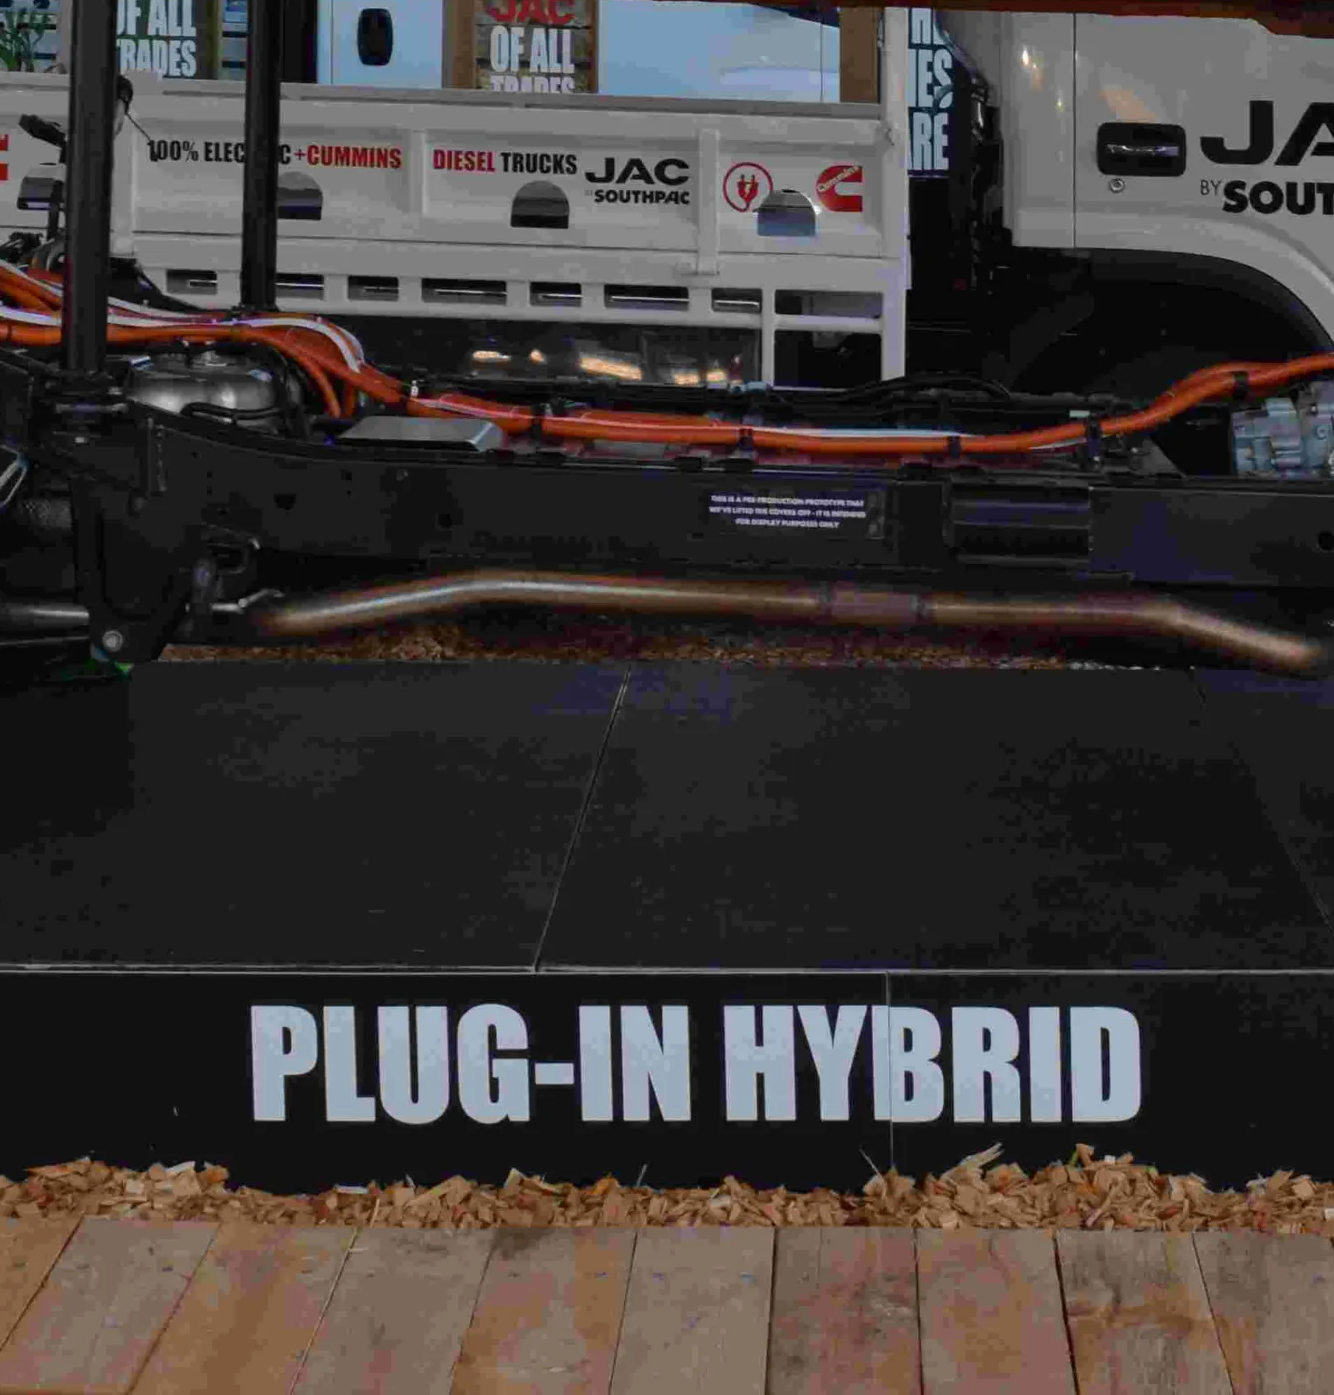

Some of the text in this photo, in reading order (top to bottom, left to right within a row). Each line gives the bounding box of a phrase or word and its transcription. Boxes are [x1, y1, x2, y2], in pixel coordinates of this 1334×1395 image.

[116, 38, 198, 77] RADES
[489, 25, 575, 74] OF ALL
[203, 141, 292, 165] ELECC
[432, 148, 496, 173] DIESEL
[500, 151, 578, 175] TRUCKS
[584, 157, 690, 187] JAC
[593, 188, 691, 206] SOUTHPAC
[1200, 179, 1222, 197] BY
[250, 1002, 1143, 1125] PLUG-IN HYBRID
